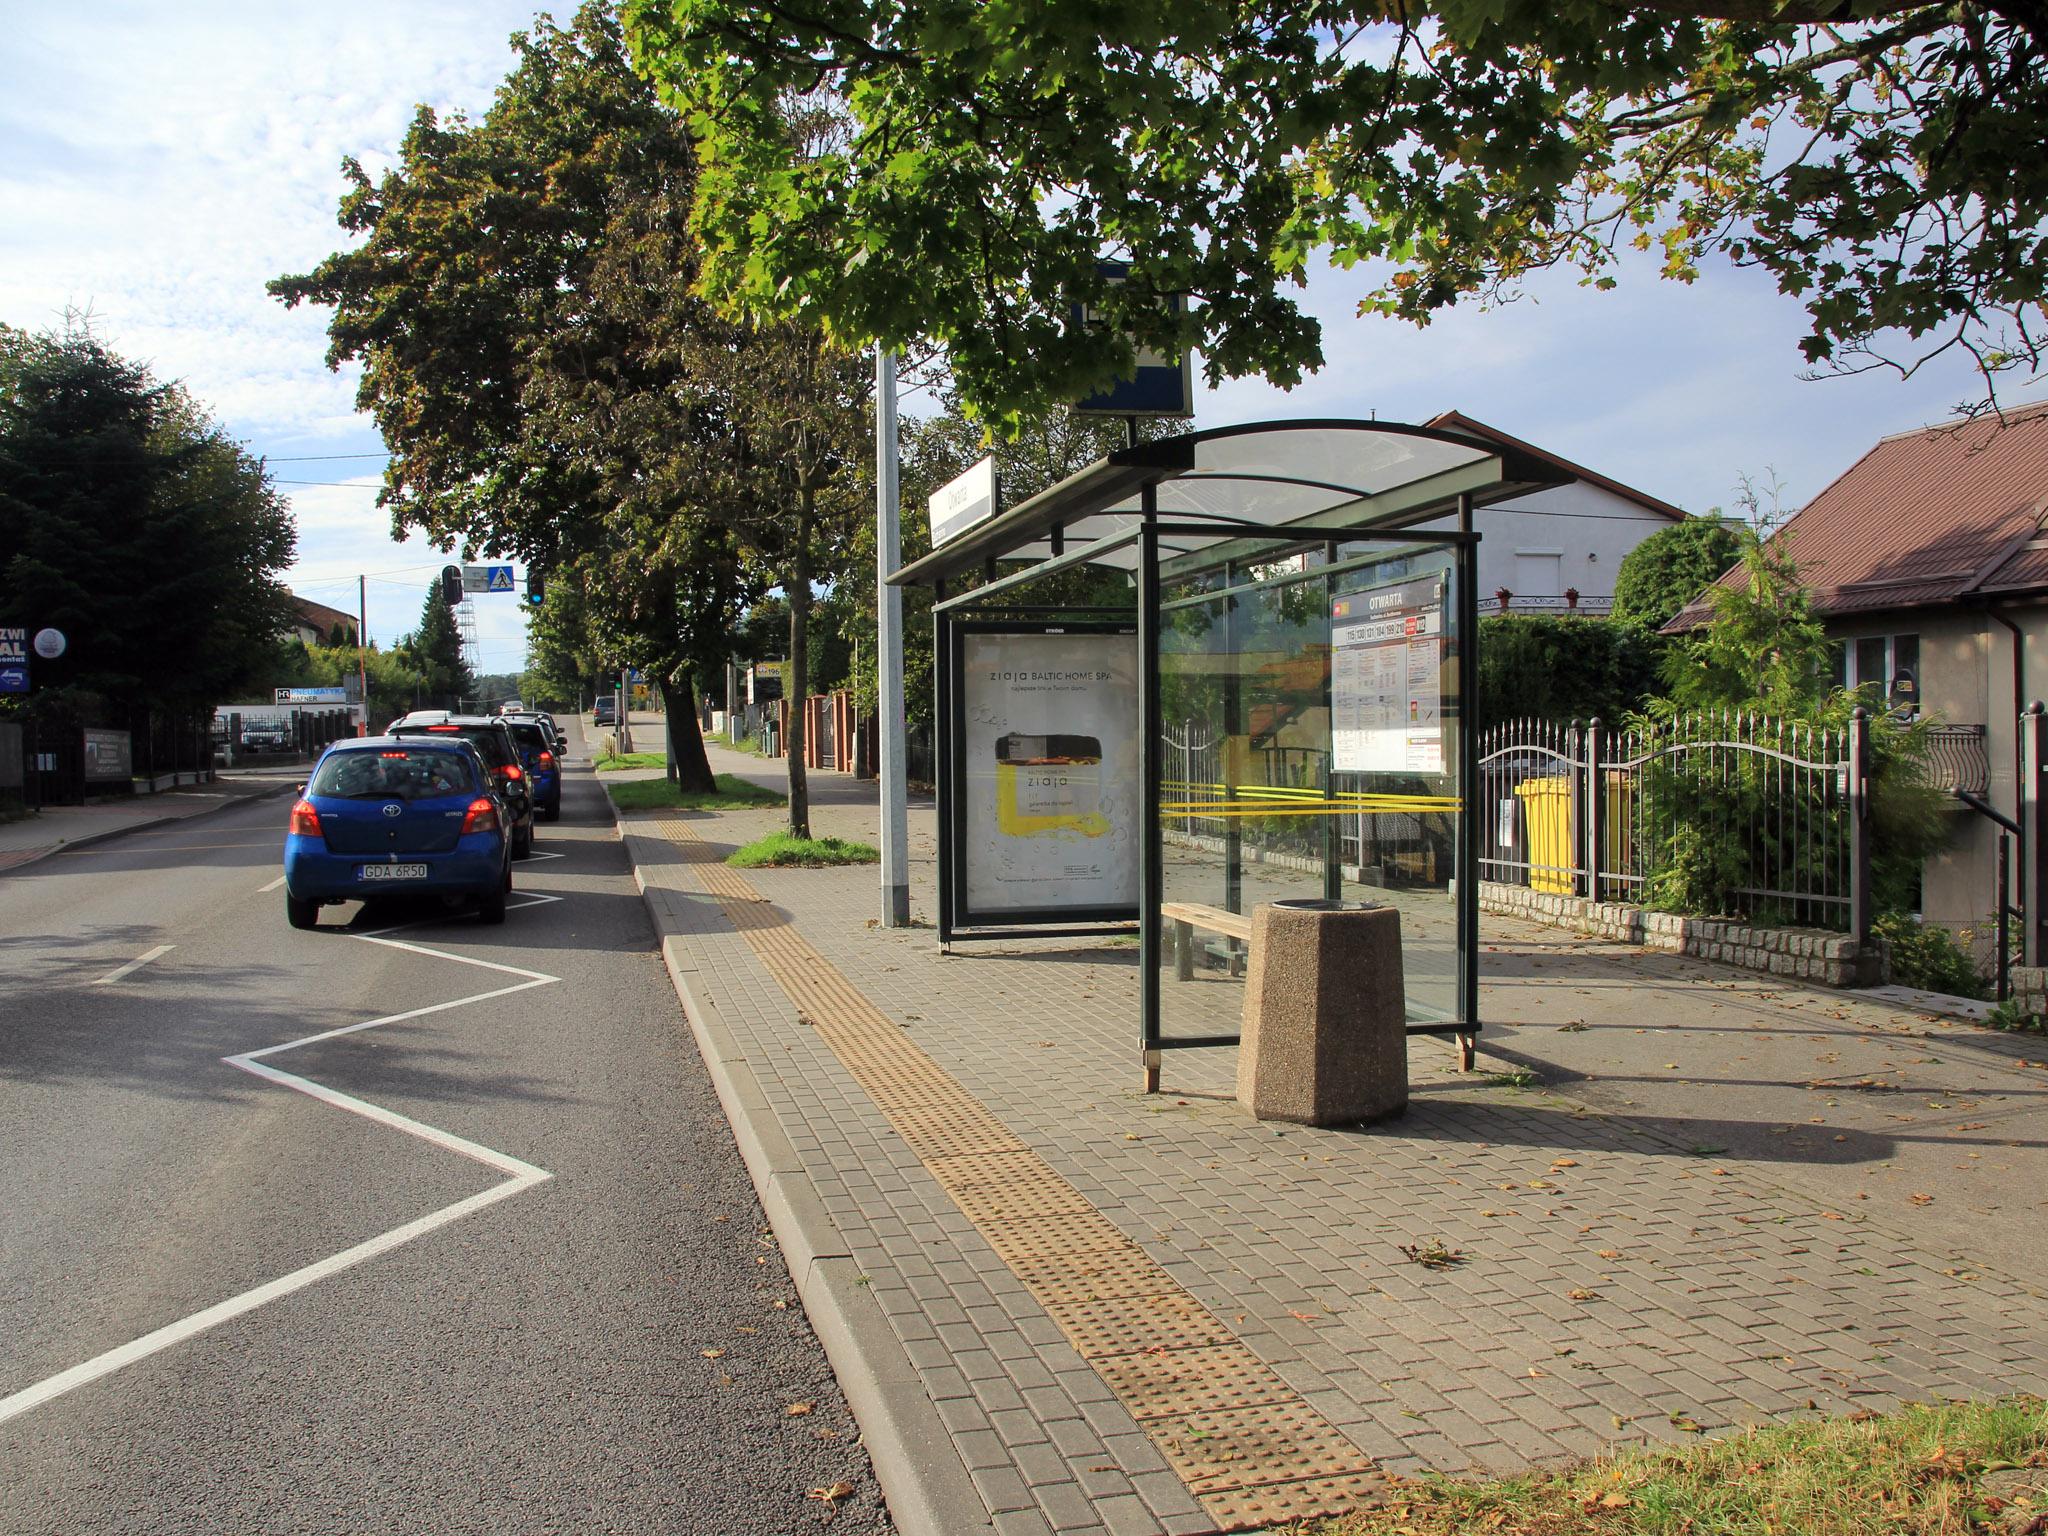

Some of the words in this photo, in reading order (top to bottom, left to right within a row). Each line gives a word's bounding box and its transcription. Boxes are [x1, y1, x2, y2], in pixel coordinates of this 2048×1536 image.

[1369, 593, 1402, 610] OTWARTA
[1347, 631, 1355, 641] 115
[1356, 628, 1365, 639] 130
[1386, 624, 1394, 635] 199
[1395, 622, 1405, 633] 210
[990, 672, 1027, 682] ziaja
[1031, 672, 1063, 680] BALTIC
[1065, 672, 1094, 680] HOME
[1095, 672, 1112, 680] SPA
[278, 690, 290, 698] HR
[1028, 777, 1068, 788] ziaja
[365, 865, 391, 878] GDA
[396, 865, 426, 877] 6R50
